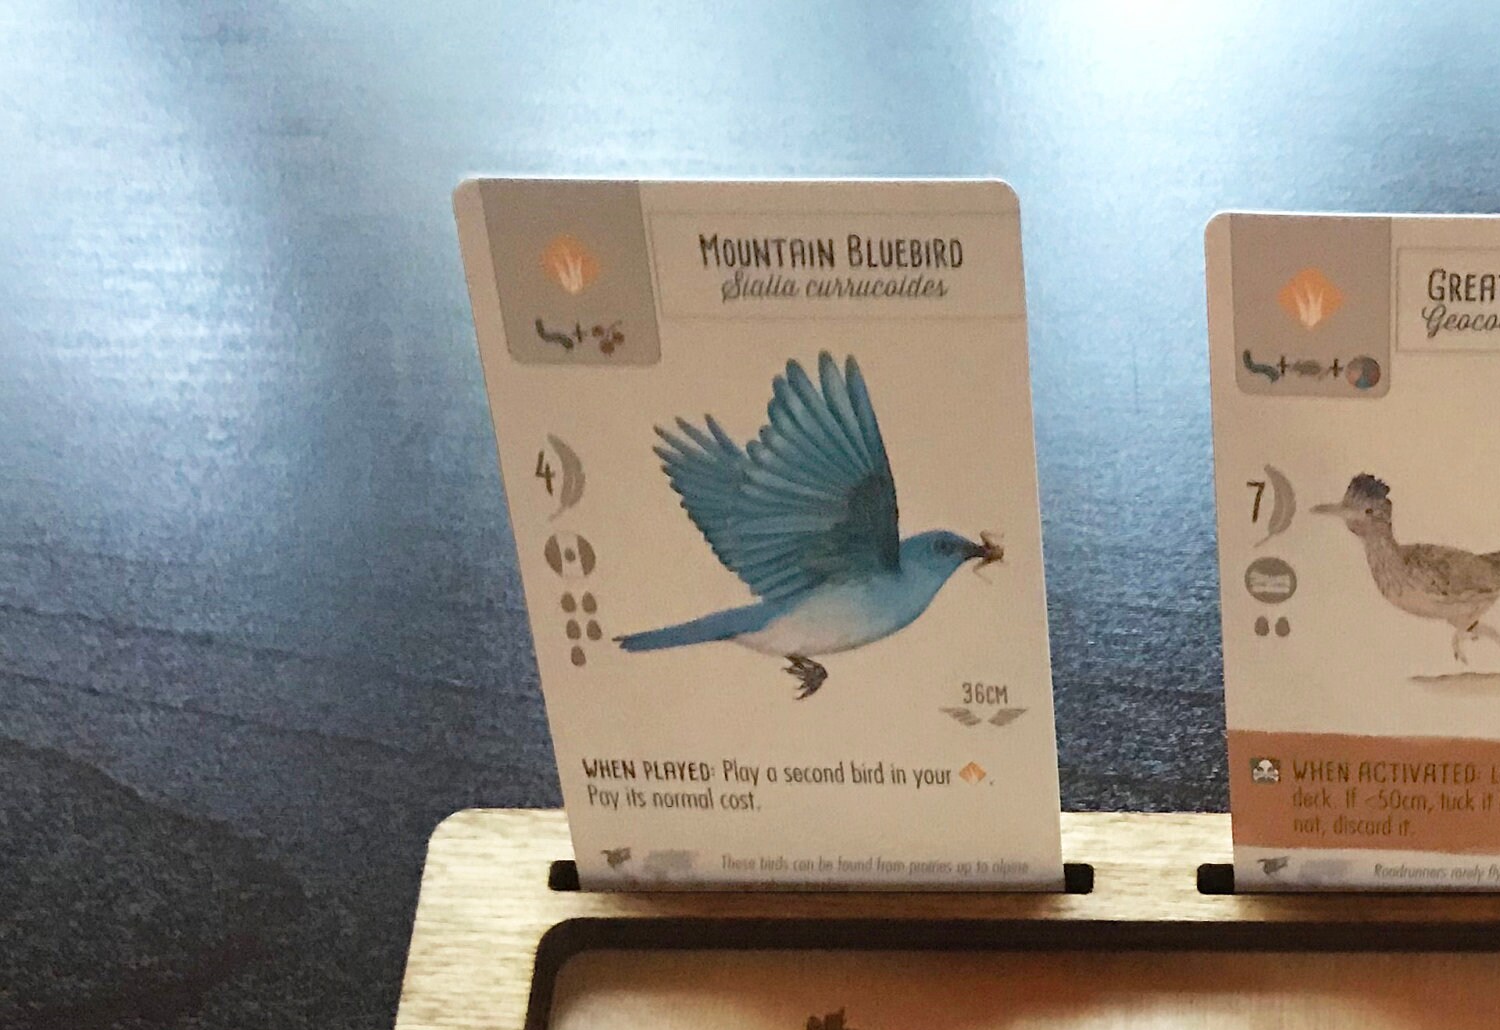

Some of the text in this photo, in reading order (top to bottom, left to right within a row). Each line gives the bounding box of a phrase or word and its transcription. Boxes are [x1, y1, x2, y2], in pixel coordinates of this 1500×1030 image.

[535, 450, 555, 496] 4
[1246, 480, 1266, 524] 7
[962, 682, 1009, 705] 36CM
[582, 758, 951, 789] WHEN PLAYED: Play a second bird in your
[1292, 760, 1350, 783] WHEN
[587, 783, 762, 812] Pay its normal cost.
[1345, 787, 1357, 810] If
[1440, 789, 1475, 812] tuck
[1482, 790, 1494, 812] it
[1333, 815, 1392, 837] discard
